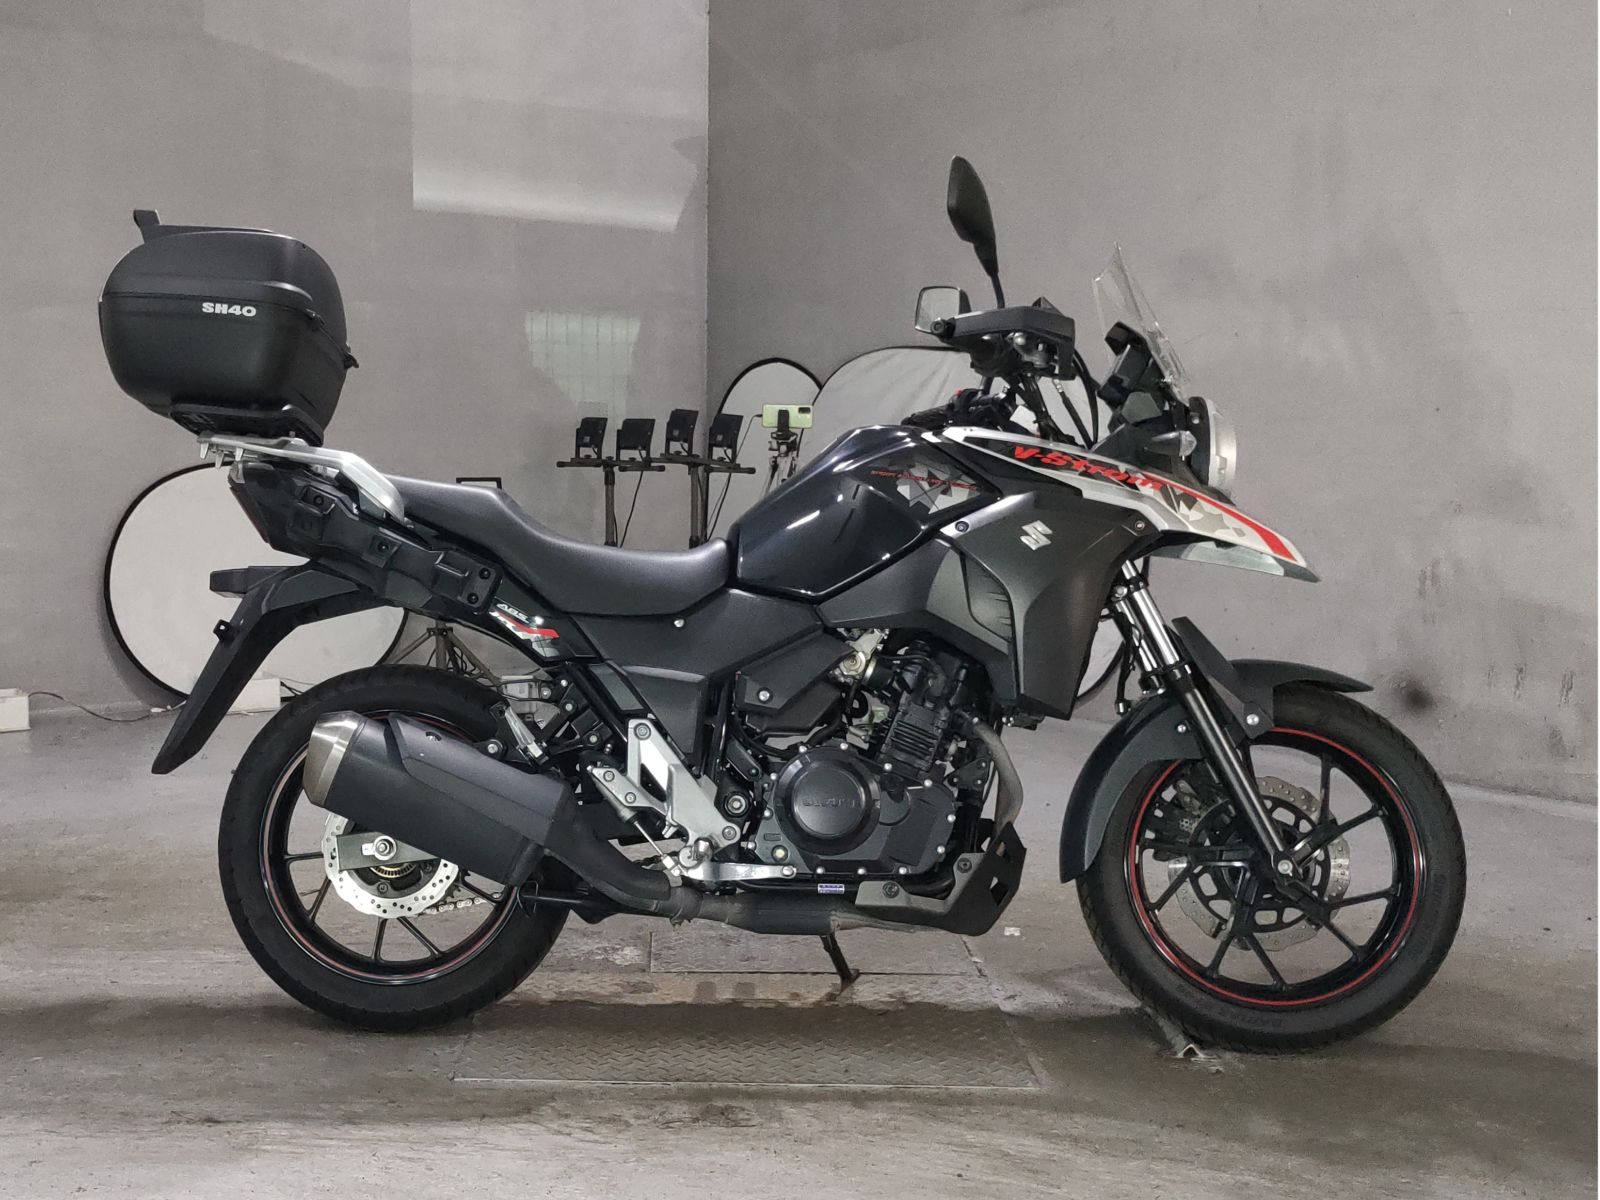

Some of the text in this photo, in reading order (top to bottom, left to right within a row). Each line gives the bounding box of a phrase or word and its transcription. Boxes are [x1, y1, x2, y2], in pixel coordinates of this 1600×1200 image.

[202, 302, 257, 317] SH40
[1014, 446, 1163, 492] V-Strom
[496, 603, 530, 624] ABS
